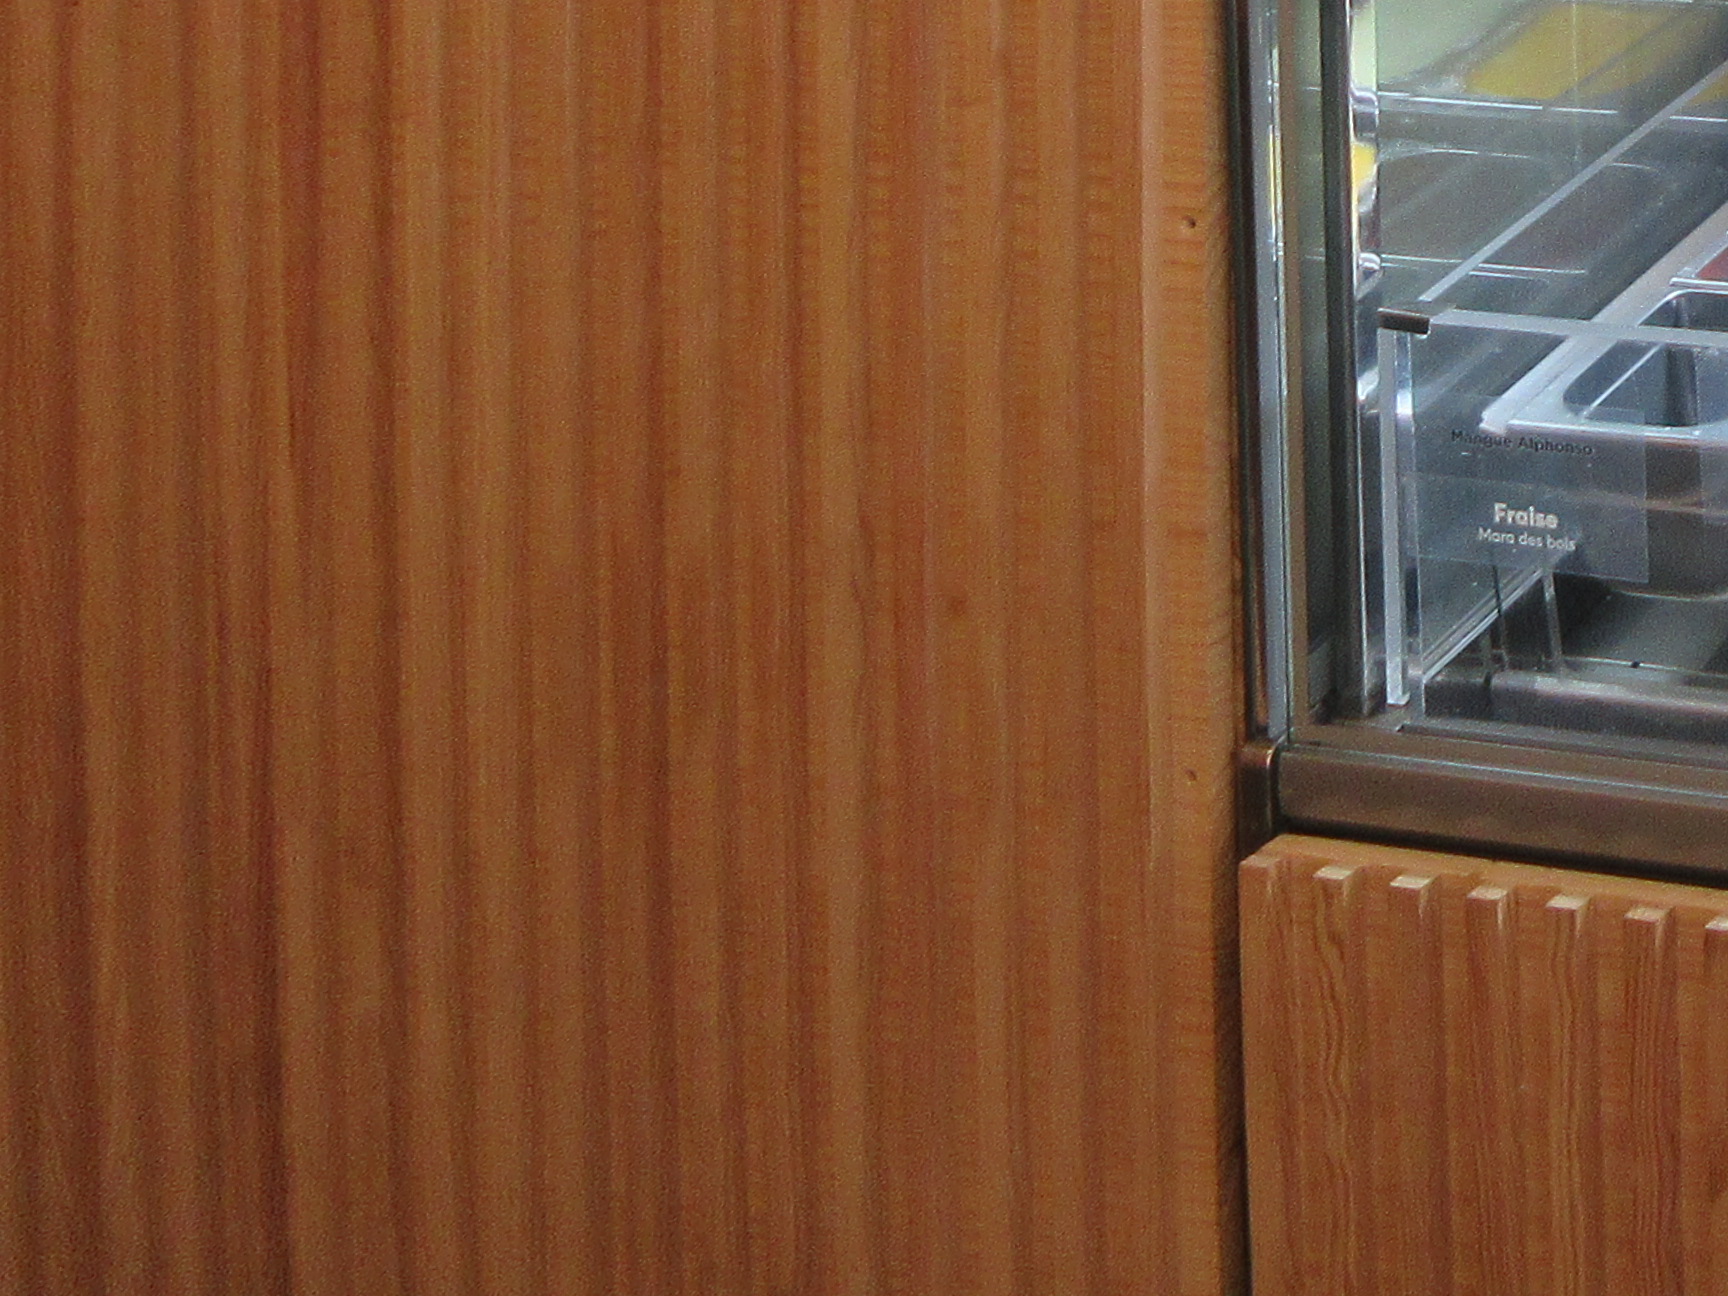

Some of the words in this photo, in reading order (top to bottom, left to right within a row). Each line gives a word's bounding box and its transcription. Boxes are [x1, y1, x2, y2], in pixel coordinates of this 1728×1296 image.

[1451, 430, 1512, 450] Mangue
[1494, 501, 1560, 530] Fraise
[1477, 526, 1515, 545] Mara
[1518, 530, 1544, 548] des
[1546, 533, 1577, 551] bois
